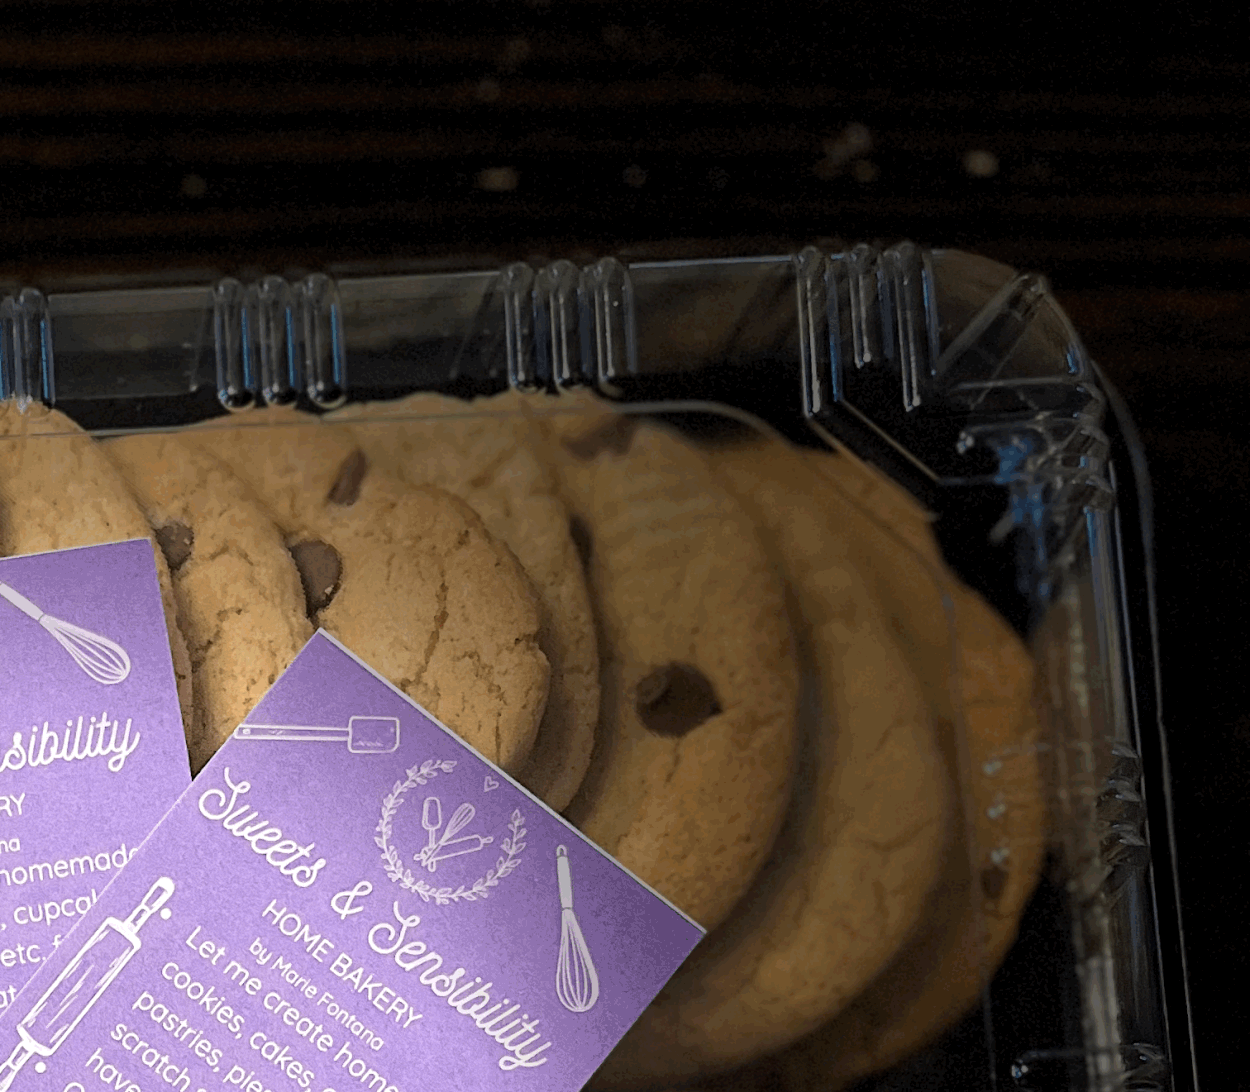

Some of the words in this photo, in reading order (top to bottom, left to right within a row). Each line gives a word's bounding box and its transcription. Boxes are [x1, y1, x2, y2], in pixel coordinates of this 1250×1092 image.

[0, 942, 47, 968] etc.
[198, 766, 327, 888] Sweets
[330, 880, 373, 921] &
[367, 900, 552, 1071] Sensibility
[261, 898, 335, 963] HOME
[329, 951, 424, 1029] BAKERY
[131, 990, 224, 1073] pastries,
[161, 961, 246, 1040] cookies,
[185, 925, 226, 966] Let
[222, 960, 263, 996] me
[263, 991, 334, 1053] create
[248, 936, 273, 966] by
[269, 955, 318, 999] Marie
[316, 991, 385, 1051] Fontana
[110, 1023, 191, 1092] scratch
